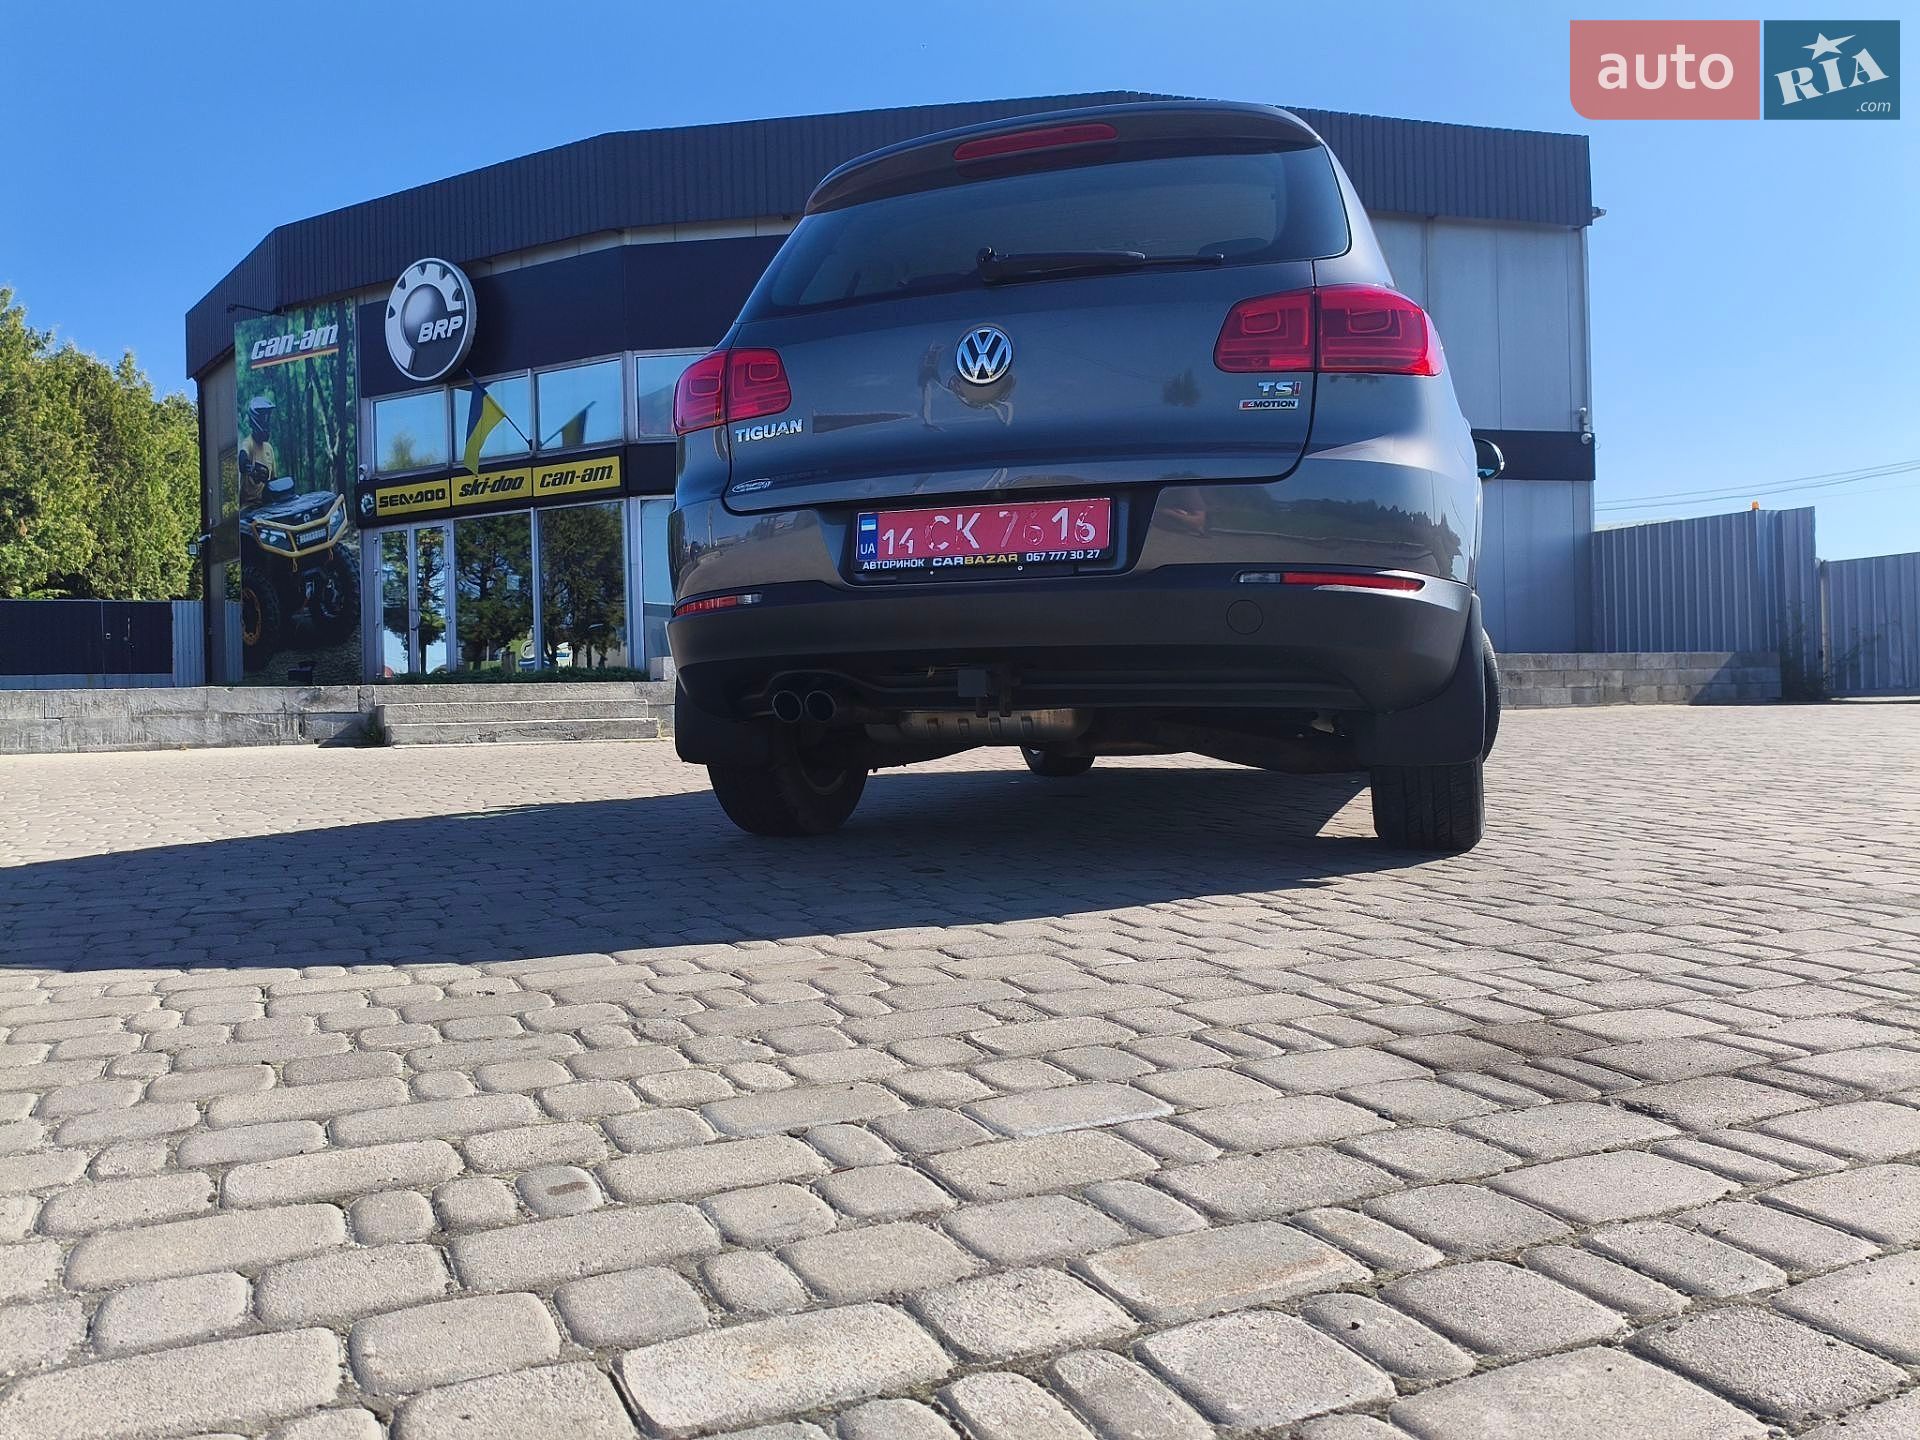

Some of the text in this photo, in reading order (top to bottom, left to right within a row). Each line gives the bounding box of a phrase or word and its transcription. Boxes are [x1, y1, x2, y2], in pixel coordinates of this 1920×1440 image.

[417, 315, 463, 343] BRP
[251, 322, 339, 360] can-am
[735, 419, 803, 442] TIGUAN
[539, 464, 614, 488] can-am
[860, 543, 876, 556] UA
[881, 527, 914, 555] 14
[862, 558, 925, 570] АВТОРИНОК
[1026, 549, 1101, 562] 067 777 30 27
